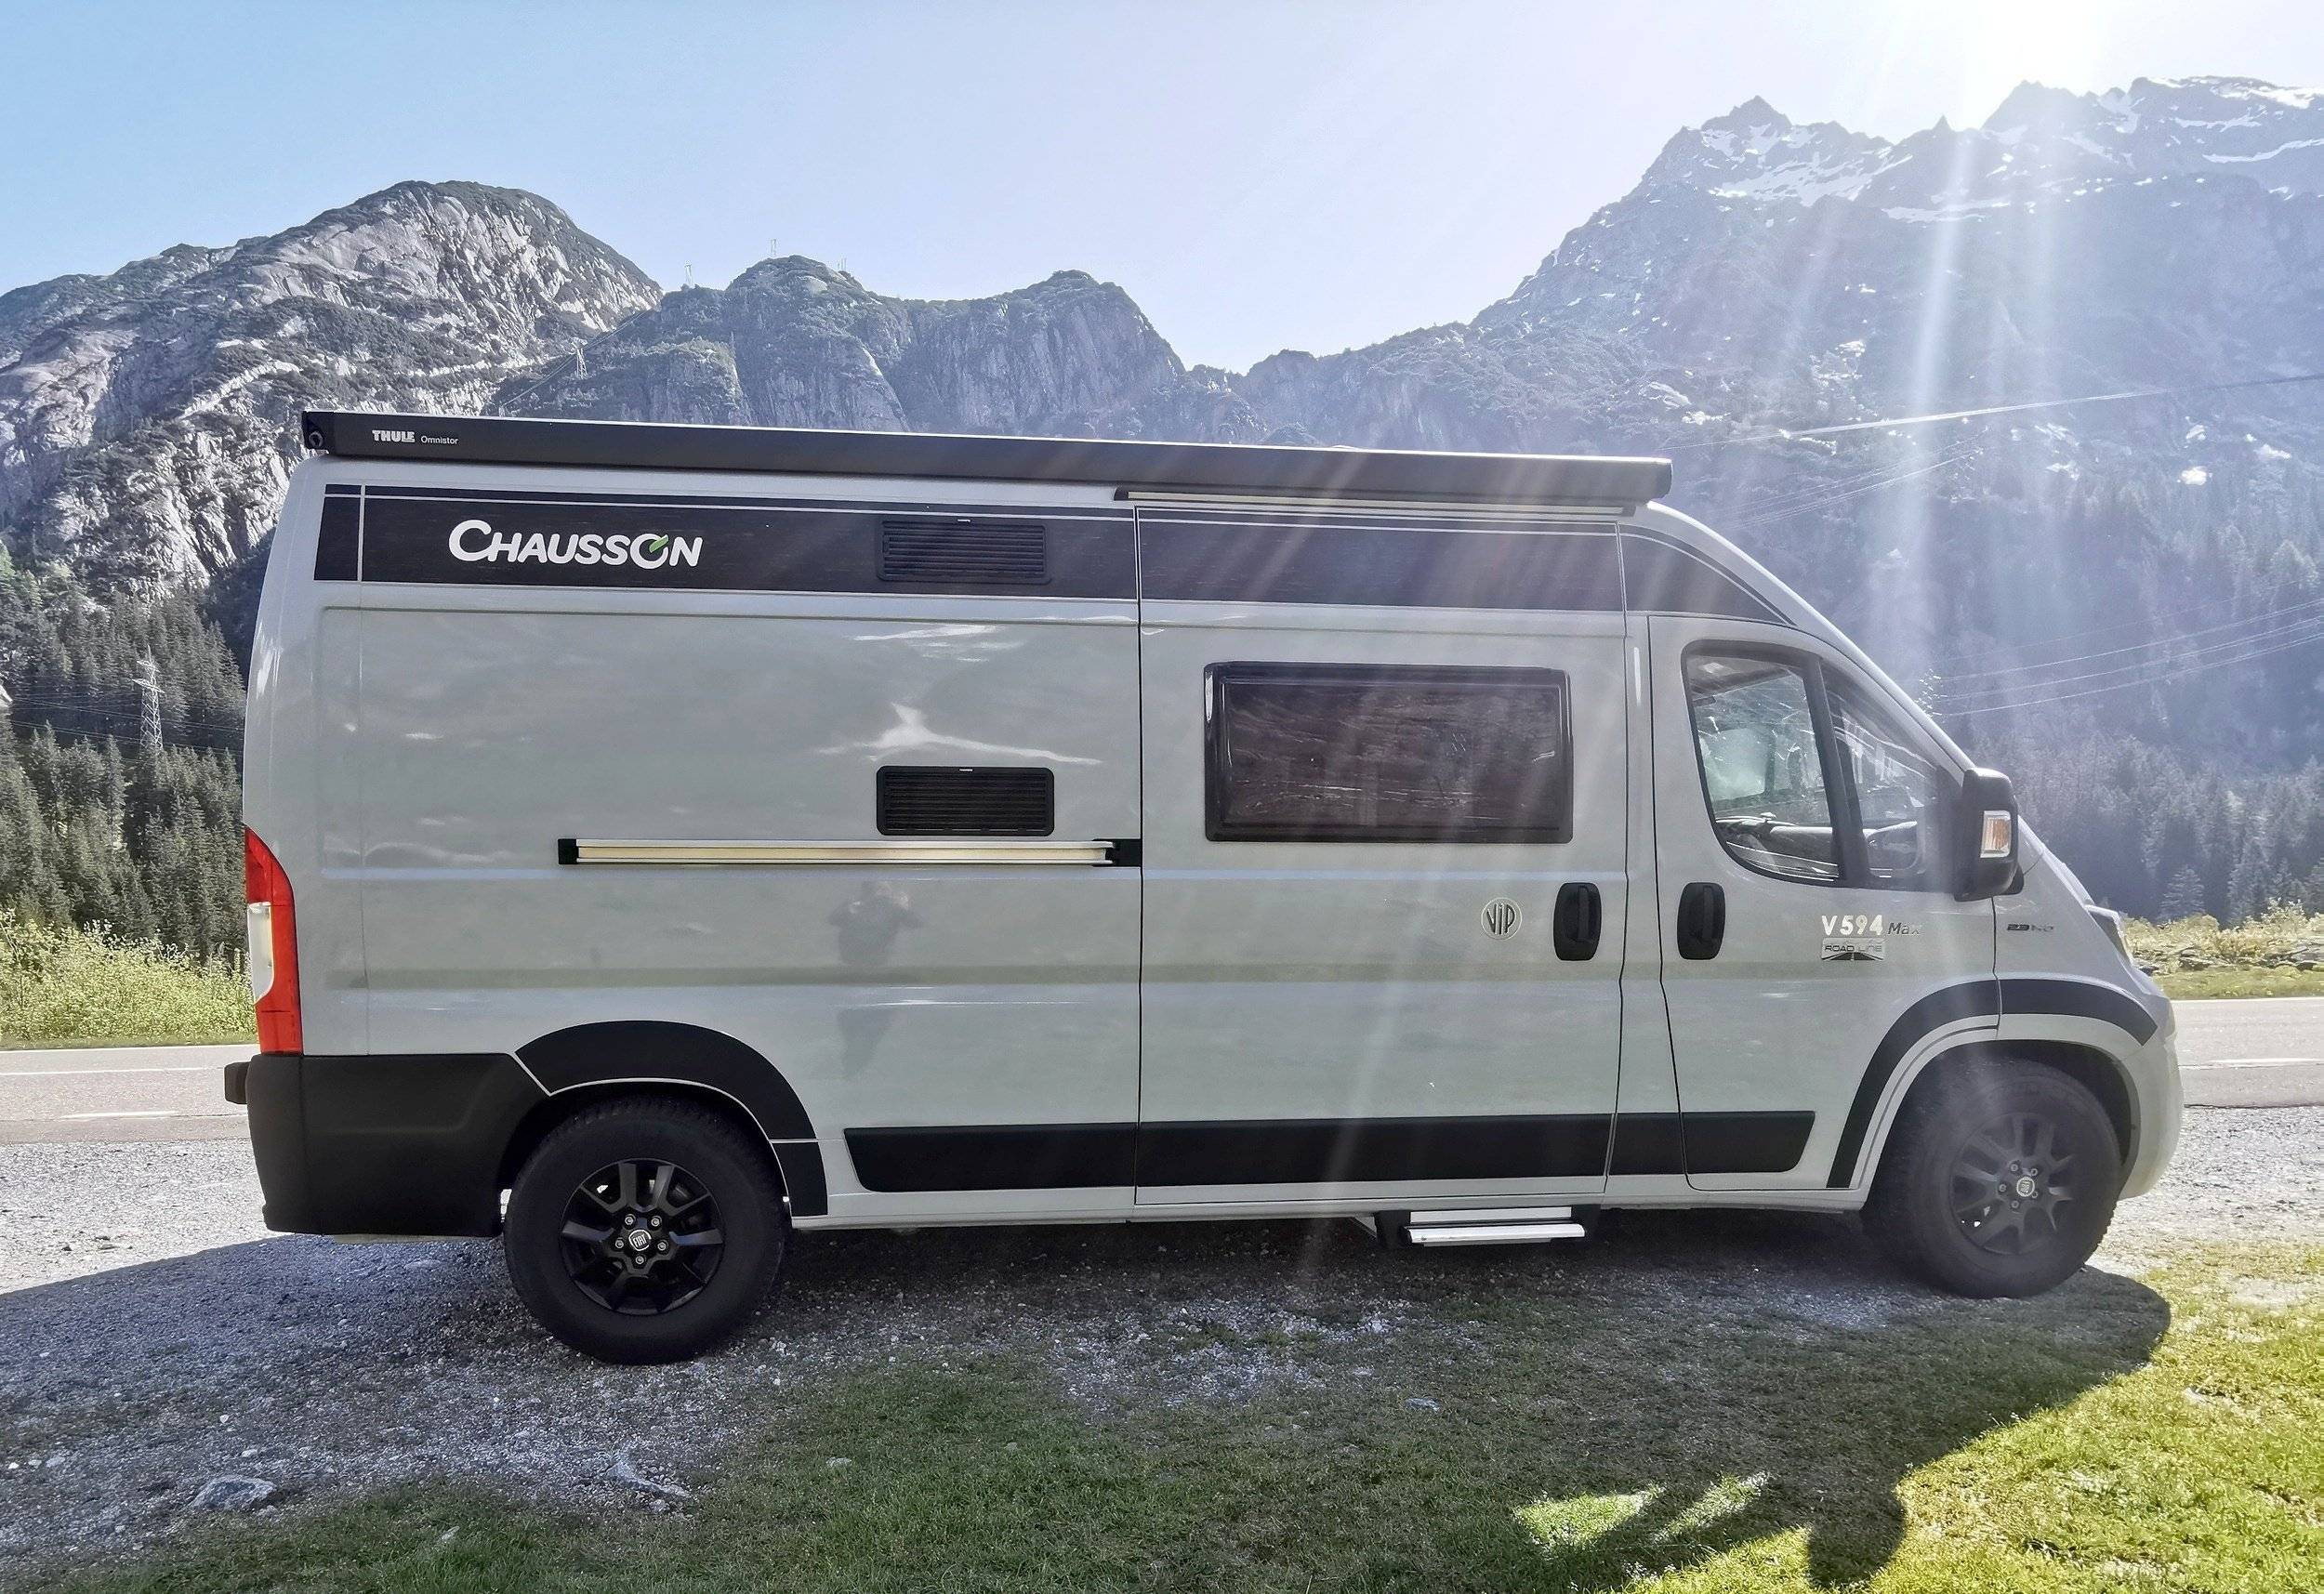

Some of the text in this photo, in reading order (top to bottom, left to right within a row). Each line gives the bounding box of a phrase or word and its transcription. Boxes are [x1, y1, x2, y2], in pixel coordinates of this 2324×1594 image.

[372, 429, 459, 444] THULE Omnistor
[448, 520, 703, 570] CHAUSSON
[1821, 914, 1883, 936] V594
